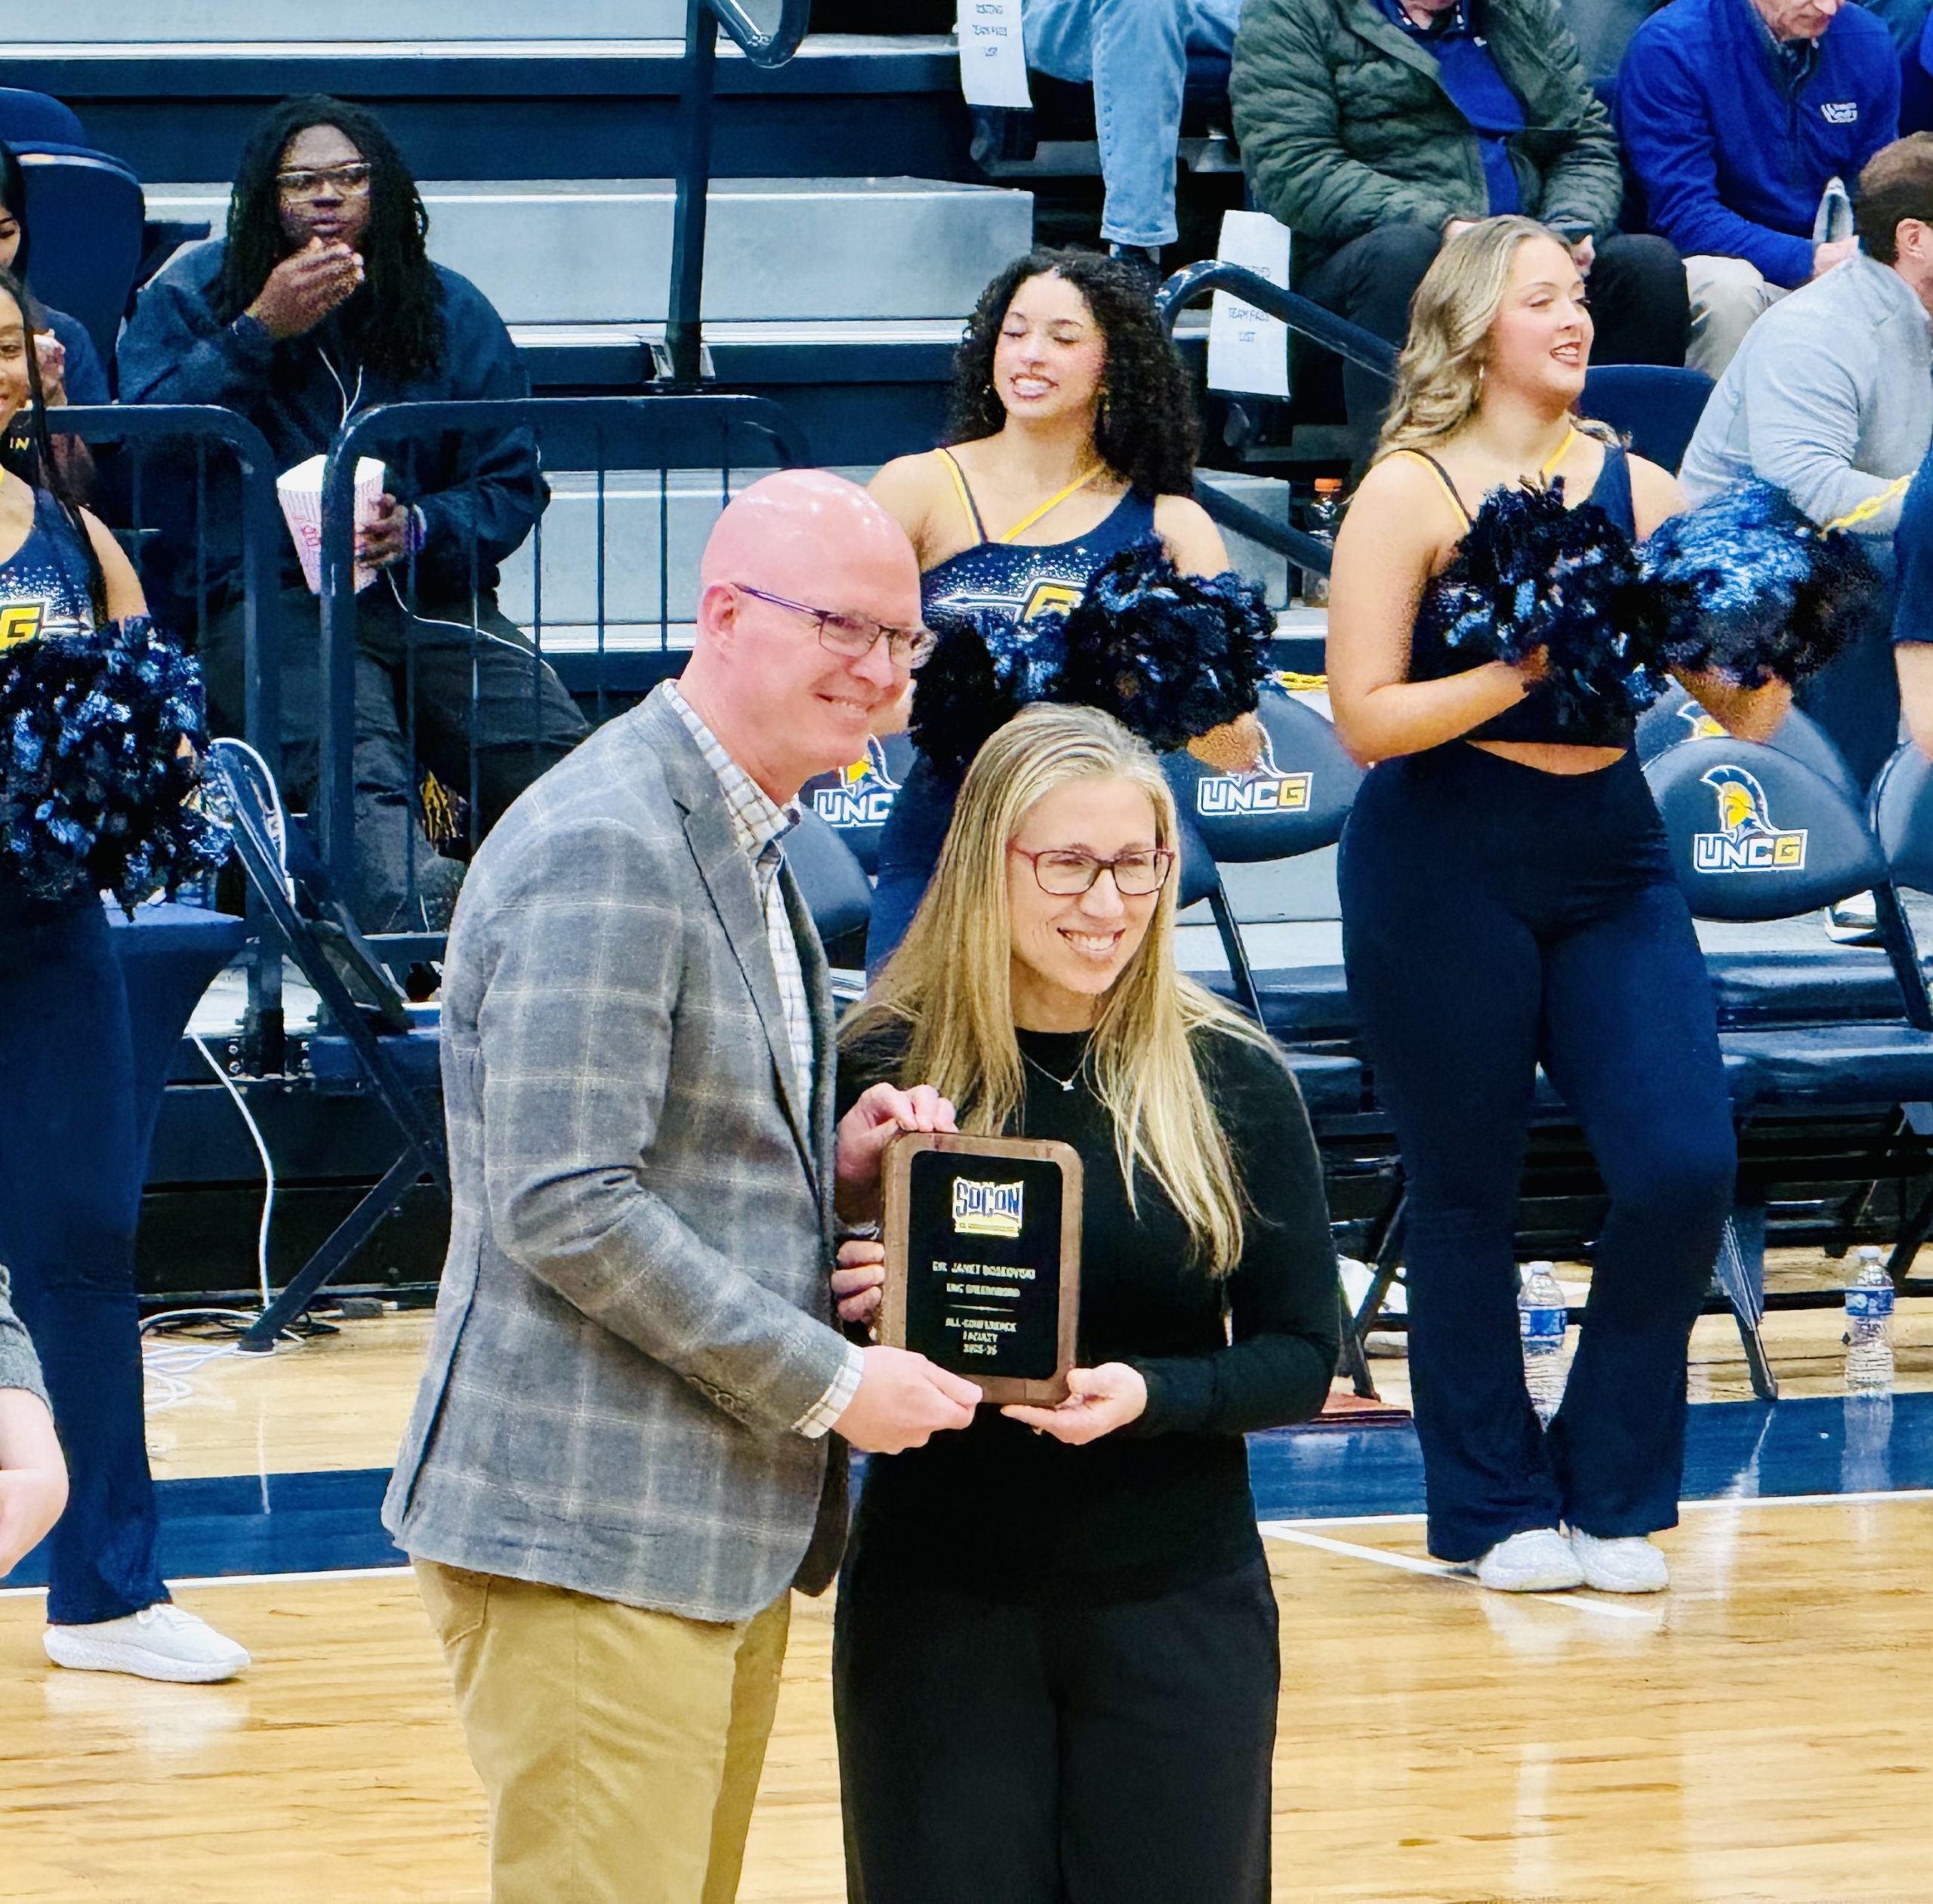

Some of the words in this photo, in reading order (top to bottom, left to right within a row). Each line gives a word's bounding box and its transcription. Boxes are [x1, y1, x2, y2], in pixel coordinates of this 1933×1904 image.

[818, 793, 894, 823] UNC
[1201, 778, 1307, 812] UNCG
[1697, 835, 1802, 867] UNCG
